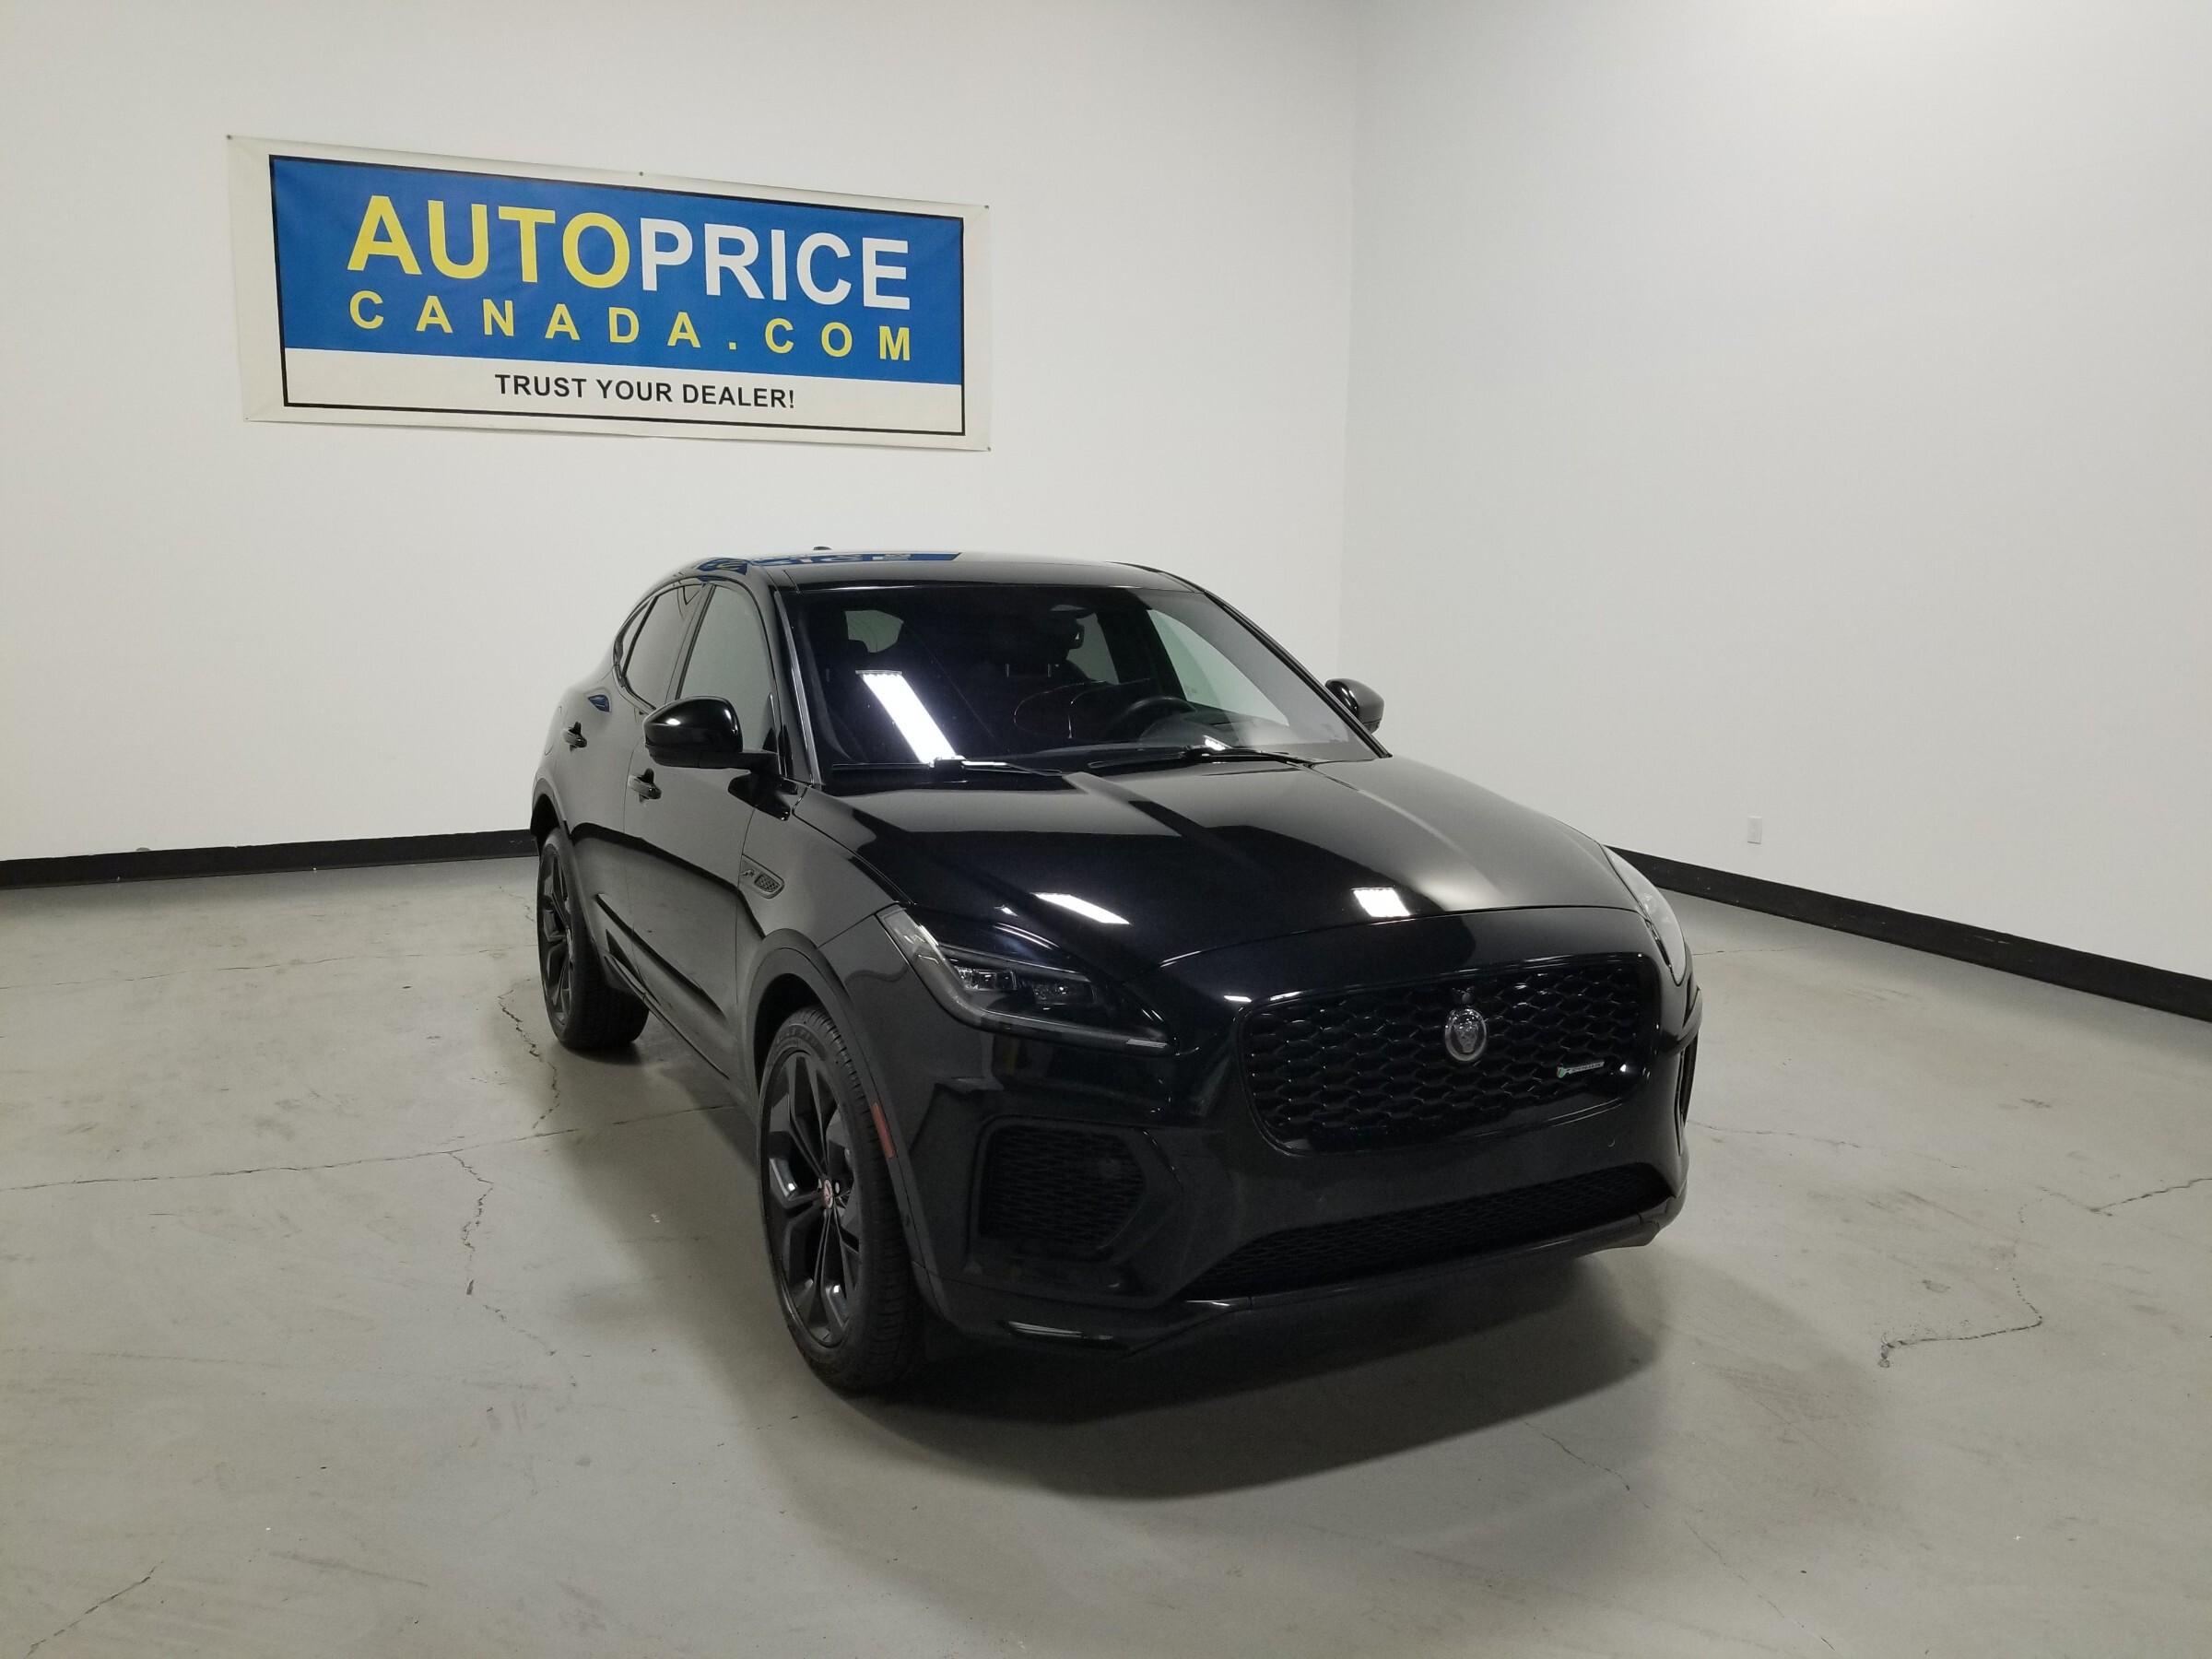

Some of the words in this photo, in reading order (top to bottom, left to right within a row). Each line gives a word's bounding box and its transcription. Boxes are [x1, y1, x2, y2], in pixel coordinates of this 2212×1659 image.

[347, 194, 911, 311] AUTOPRICE
[348, 290, 912, 362] CANADA.COM
[494, 373, 587, 399] TRUST
[595, 379, 674, 404] YOUR
[682, 382, 796, 409] DEALER!
